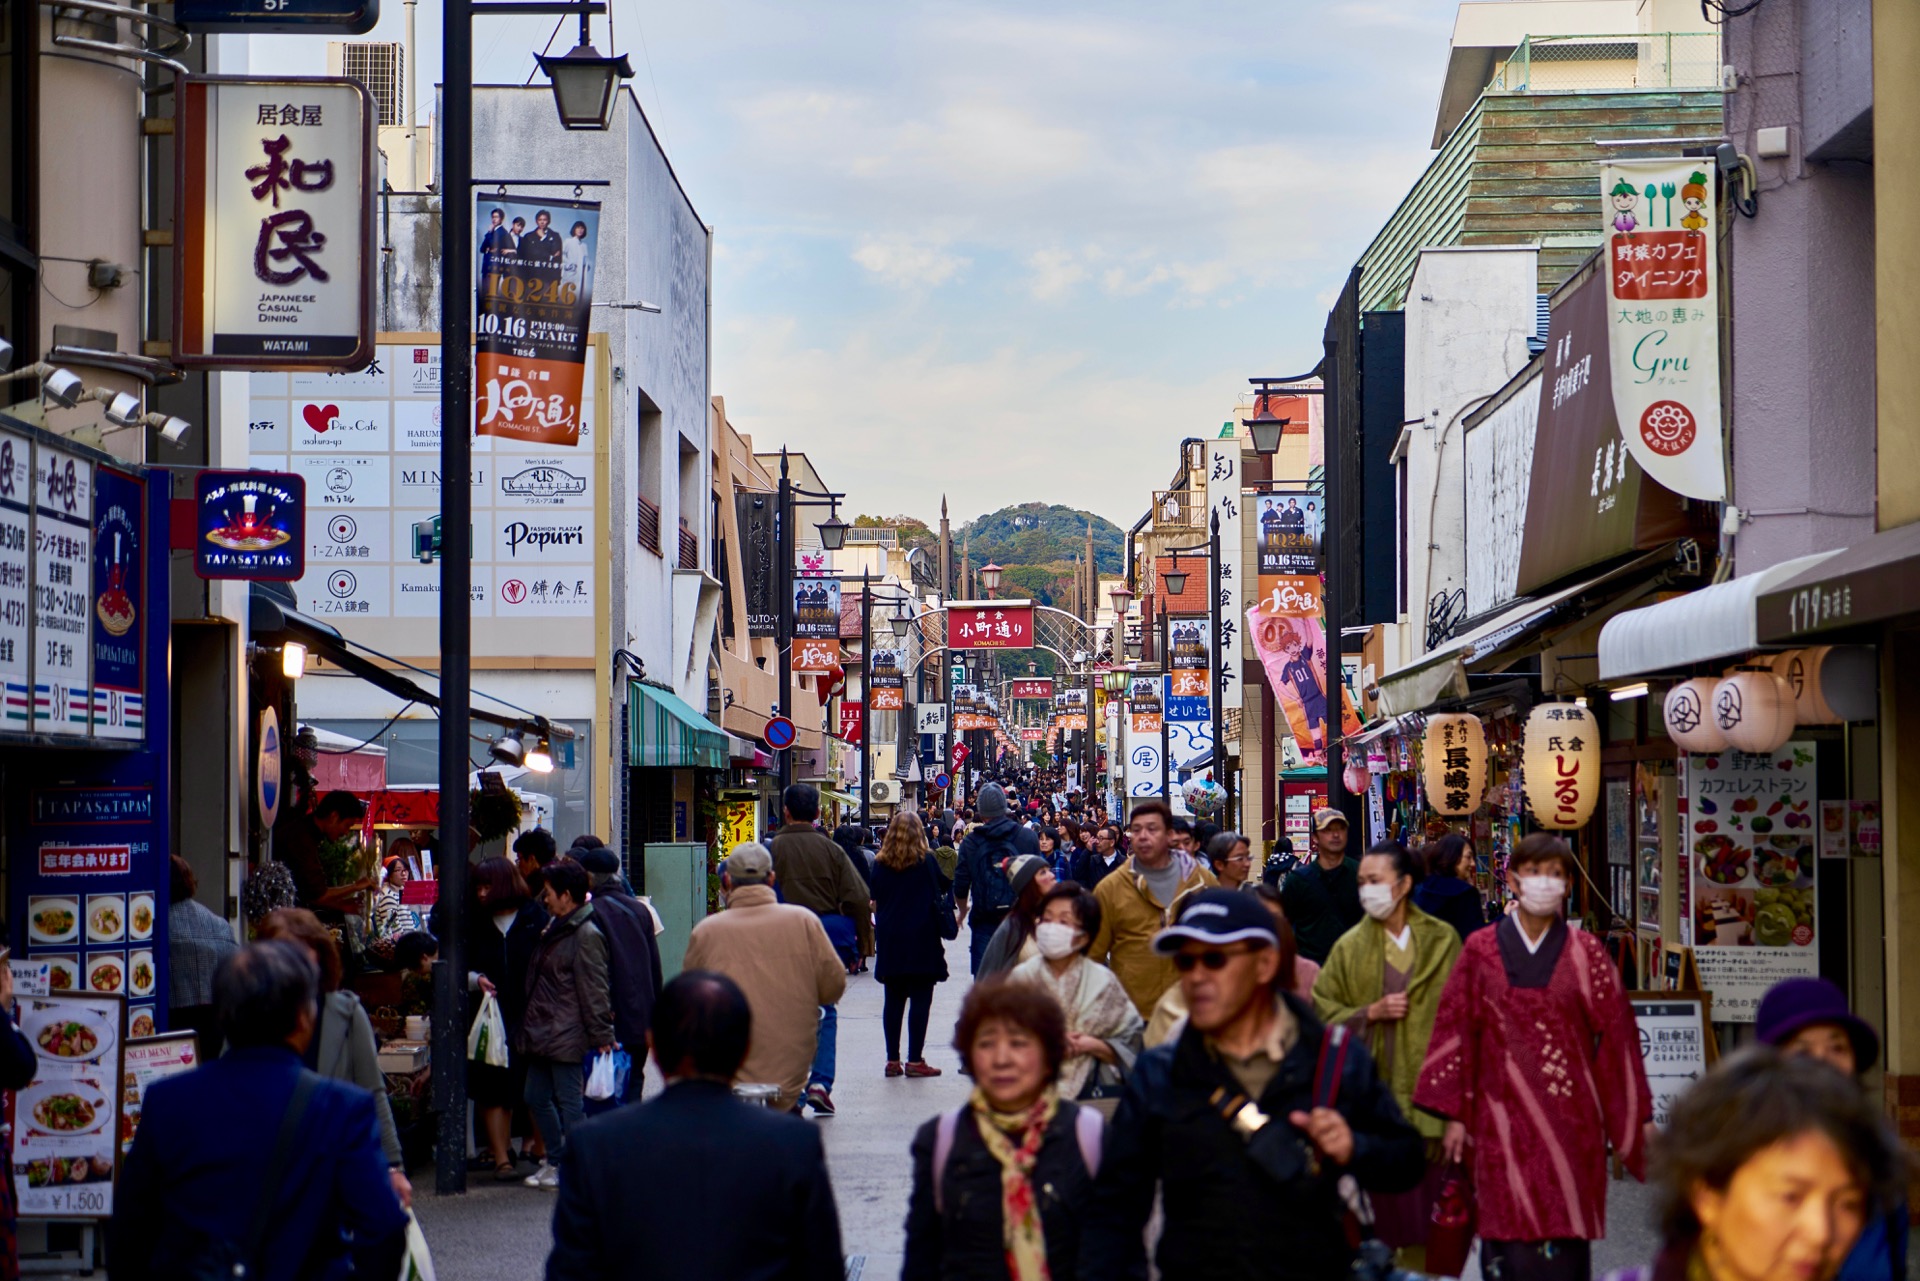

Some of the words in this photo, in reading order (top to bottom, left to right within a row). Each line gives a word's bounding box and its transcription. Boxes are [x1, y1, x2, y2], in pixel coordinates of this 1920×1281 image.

[256, 104, 323, 126] 居食屋
[244, 134, 335, 285] 和民
[1617, 242, 1698, 261] 野菜カフェ
[1617, 269, 1703, 288] ダイニング
[259, 293, 316, 303] JAPANESE
[486, 273, 577, 306] IQ246
[258, 303, 303, 313] CASUAL
[1617, 307, 1705, 324] 大地の恵み
[258, 313, 298, 323] DINING
[477, 313, 526, 338] 10.16
[263, 340, 309, 351] WATAMI
[528, 330, 579, 344] START
[1632, 329, 1690, 384] Gru
[331, 419, 347, 431] Pie
[355, 419, 378, 431] Cafe
[497, 420, 531, 433] KOMACHI
[508, 480, 581, 490] KAMAKURA
[1267, 534, 1313, 546] IQ246
[1263, 554, 1290, 566] 10.16
[531, 579, 588, 601] 鎌倉屋
[796, 623, 816, 632] 10.16
[959, 620, 1022, 638] 小町通り
[1174, 655, 1191, 664] 10.16
[1295, 671, 1310, 686] 01
[53, 682, 69, 721] 3F
[109, 691, 124, 727] B1
[1443, 723, 1455, 748] 和菓子
[1457, 719, 1468, 744] 手作り
[1731, 752, 1774, 771] 野菜
[1442, 747, 1471, 811] 長嶋家
[1699, 778, 1807, 794] カフェレストラン
[1554, 755, 1580, 825] しるこ
[43, 852, 128, 867] 忘年会承ります
[1653, 1054, 1701, 1062] GRAPHIC
